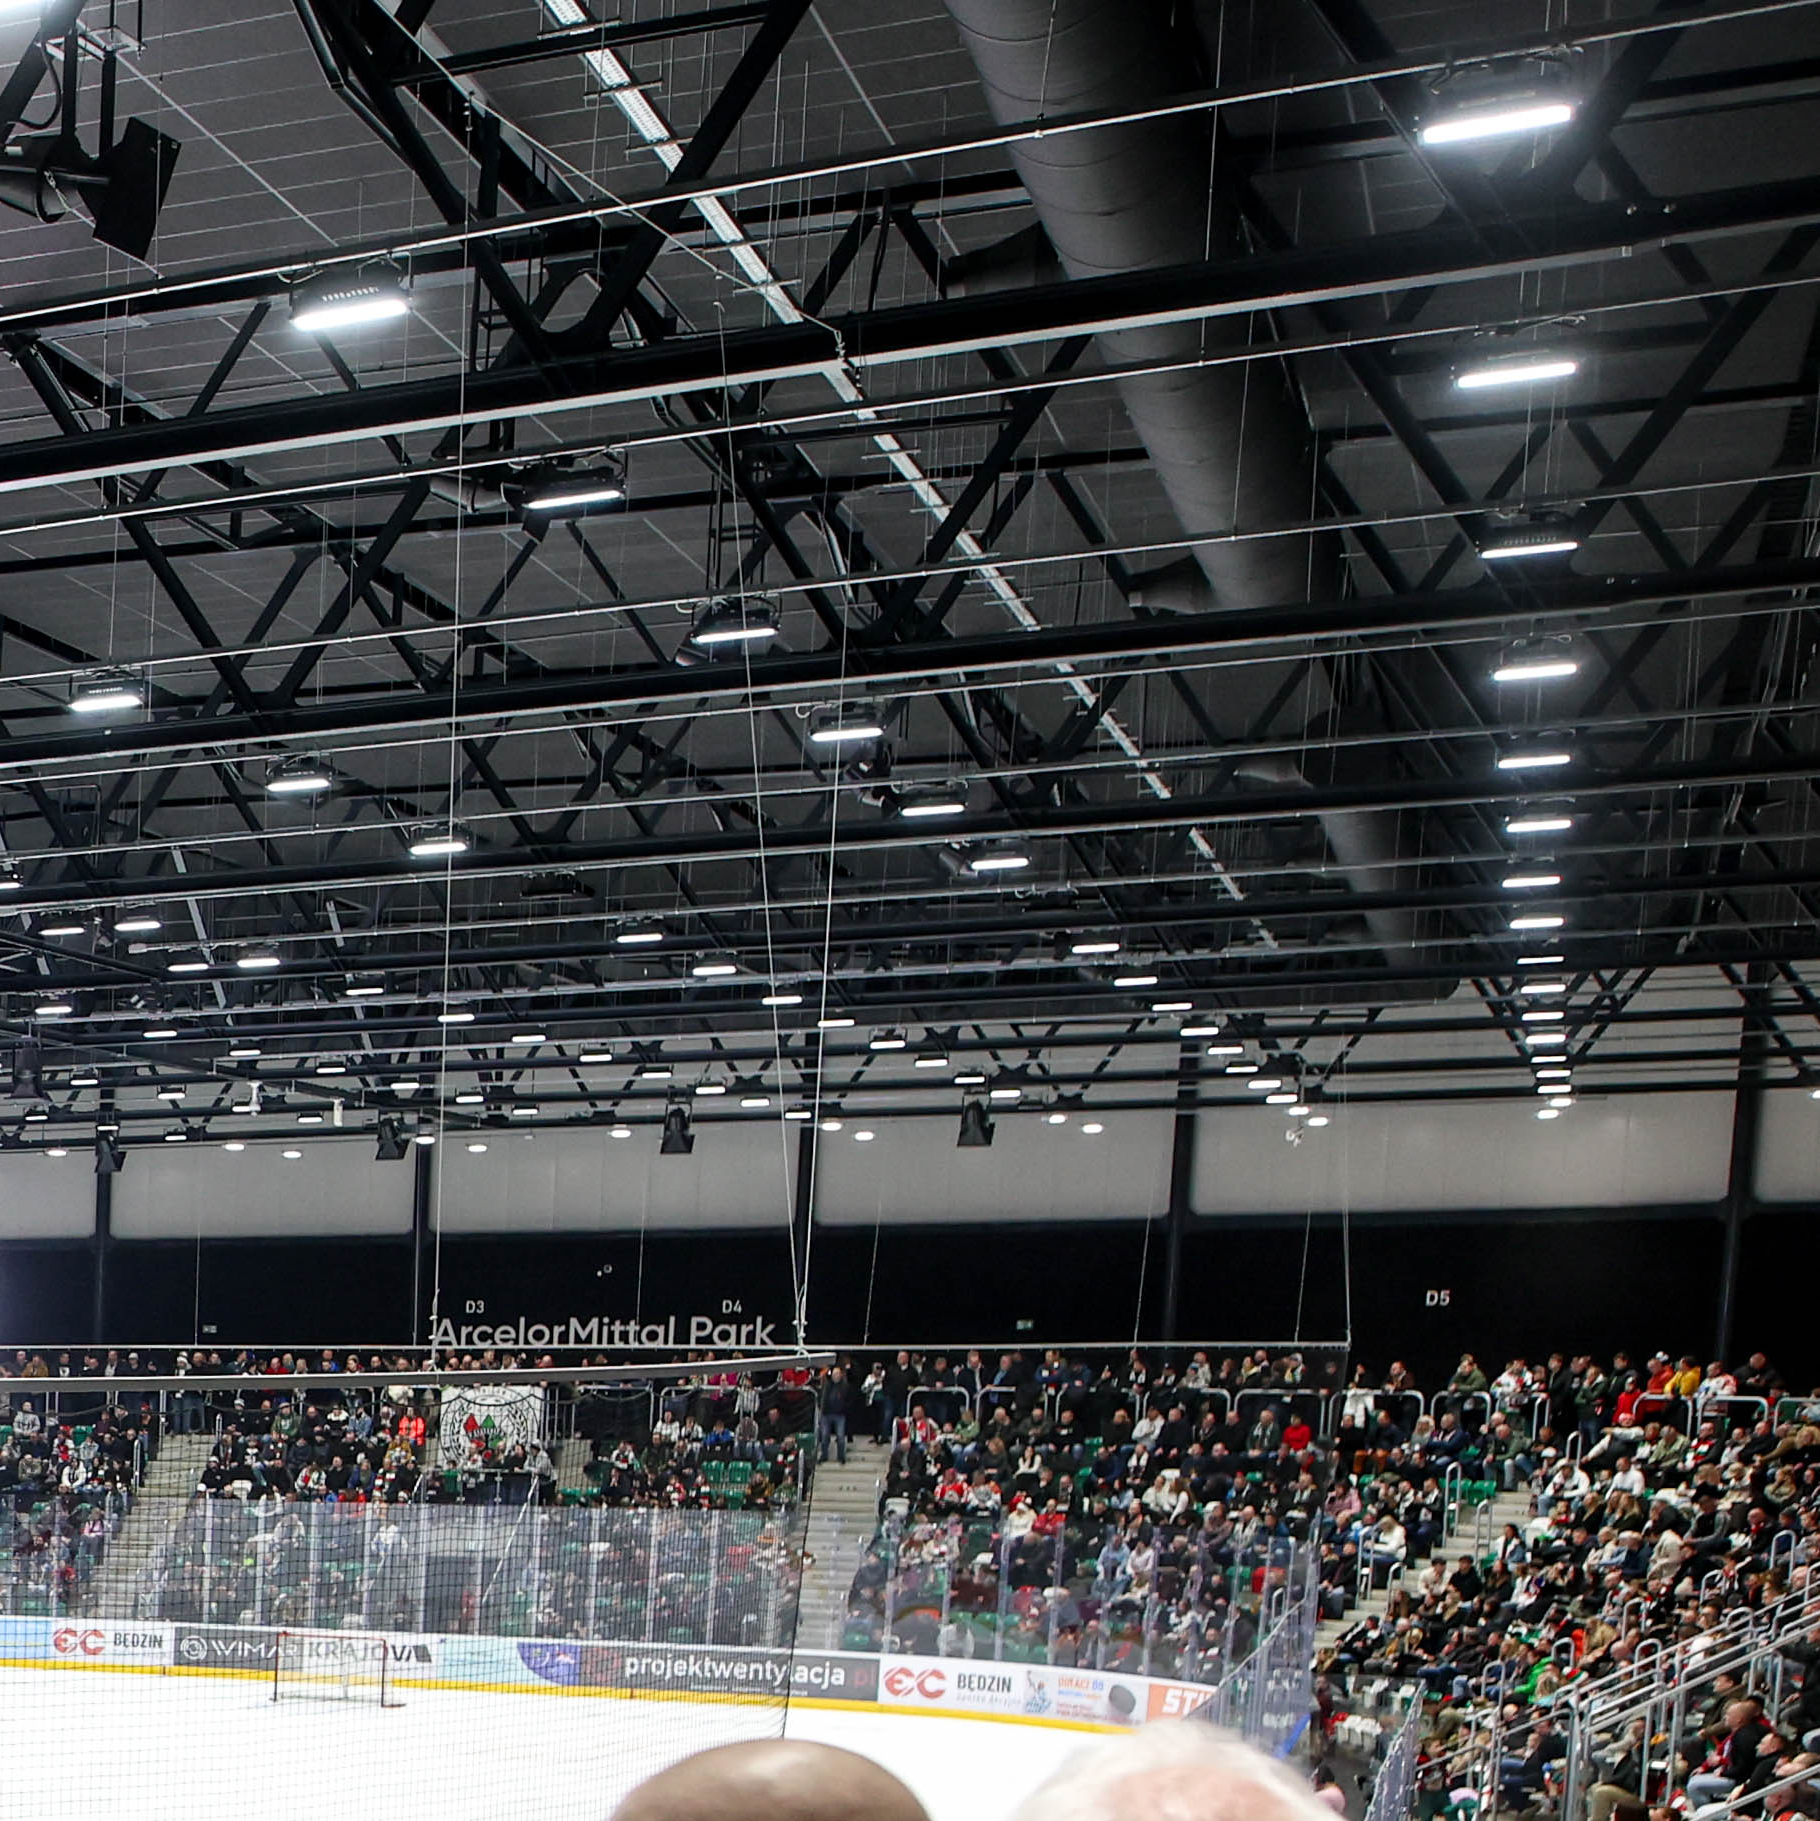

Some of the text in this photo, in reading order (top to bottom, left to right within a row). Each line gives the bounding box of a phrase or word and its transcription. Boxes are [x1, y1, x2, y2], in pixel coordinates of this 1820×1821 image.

[1425, 1290, 1451, 1306] D5
[466, 1300, 485, 1314] D3
[722, 1300, 742, 1314] D4
[436, 1315, 776, 1346] ArcelorMittal Park
[957, 1671, 1012, 1695] BĘDZIN
